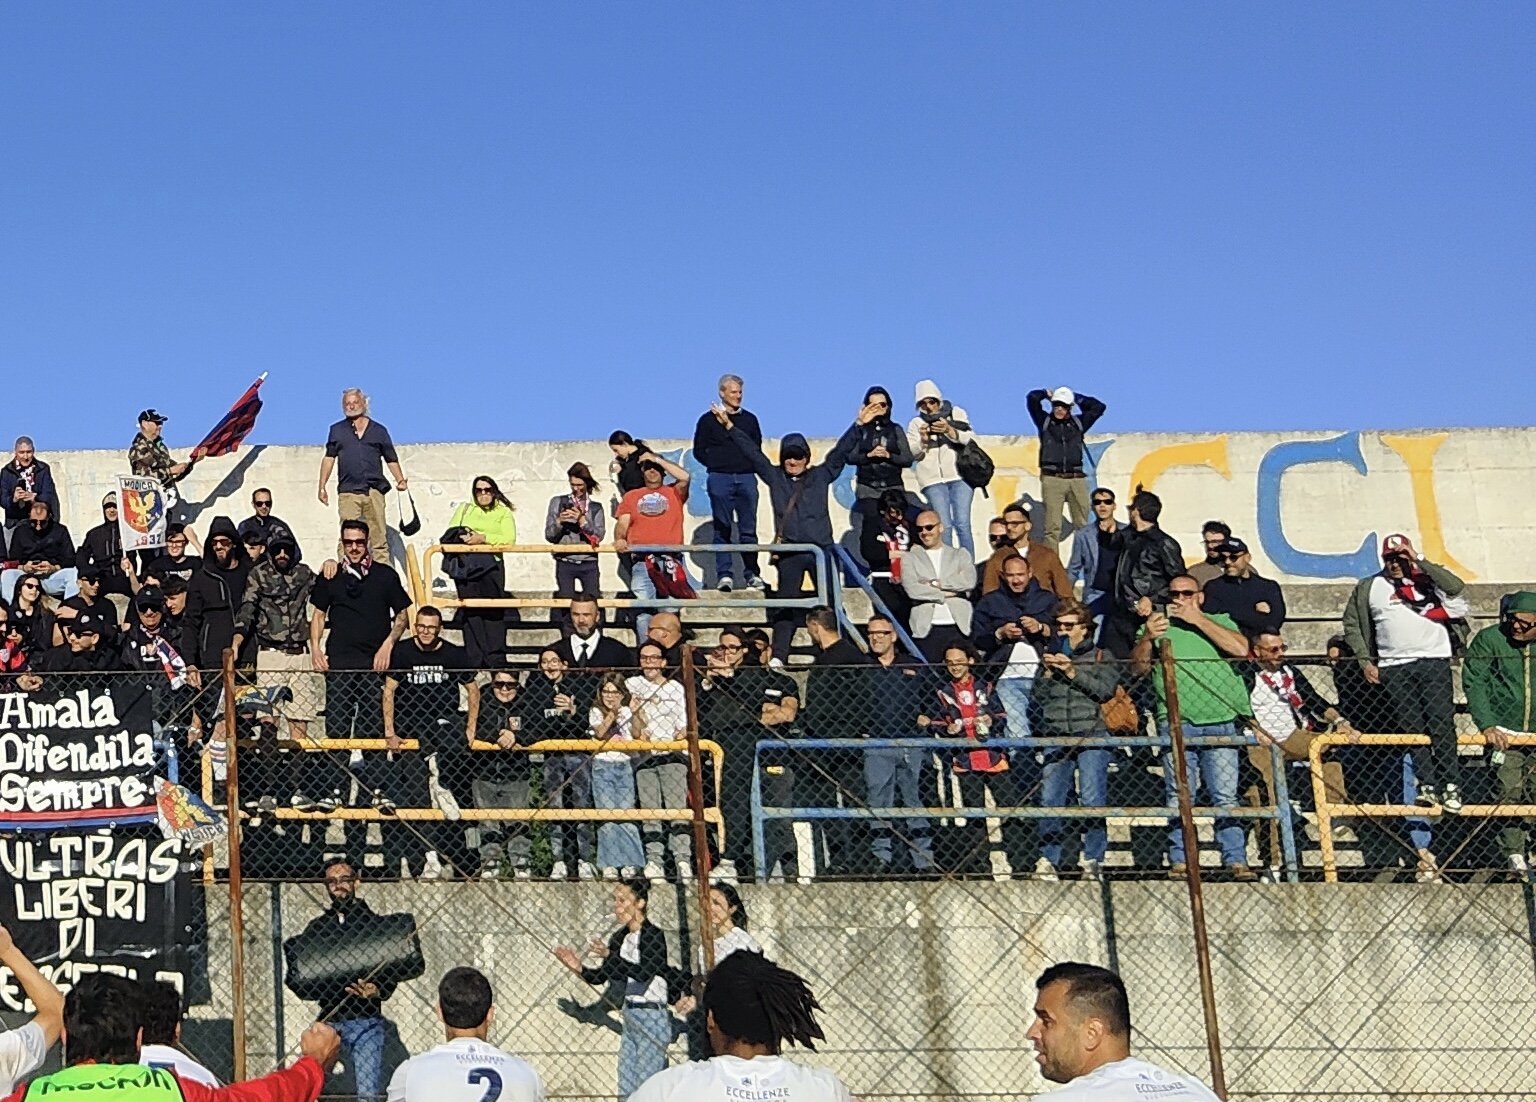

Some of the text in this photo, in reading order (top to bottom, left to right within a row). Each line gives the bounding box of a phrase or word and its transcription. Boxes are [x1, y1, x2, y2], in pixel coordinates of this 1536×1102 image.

[0, 833, 182, 883] ULTRAS
[15, 878, 146, 922] LIBERI
[59, 917, 95, 959] DI
[726, 1087, 790, 1100] ECCELLENZE
